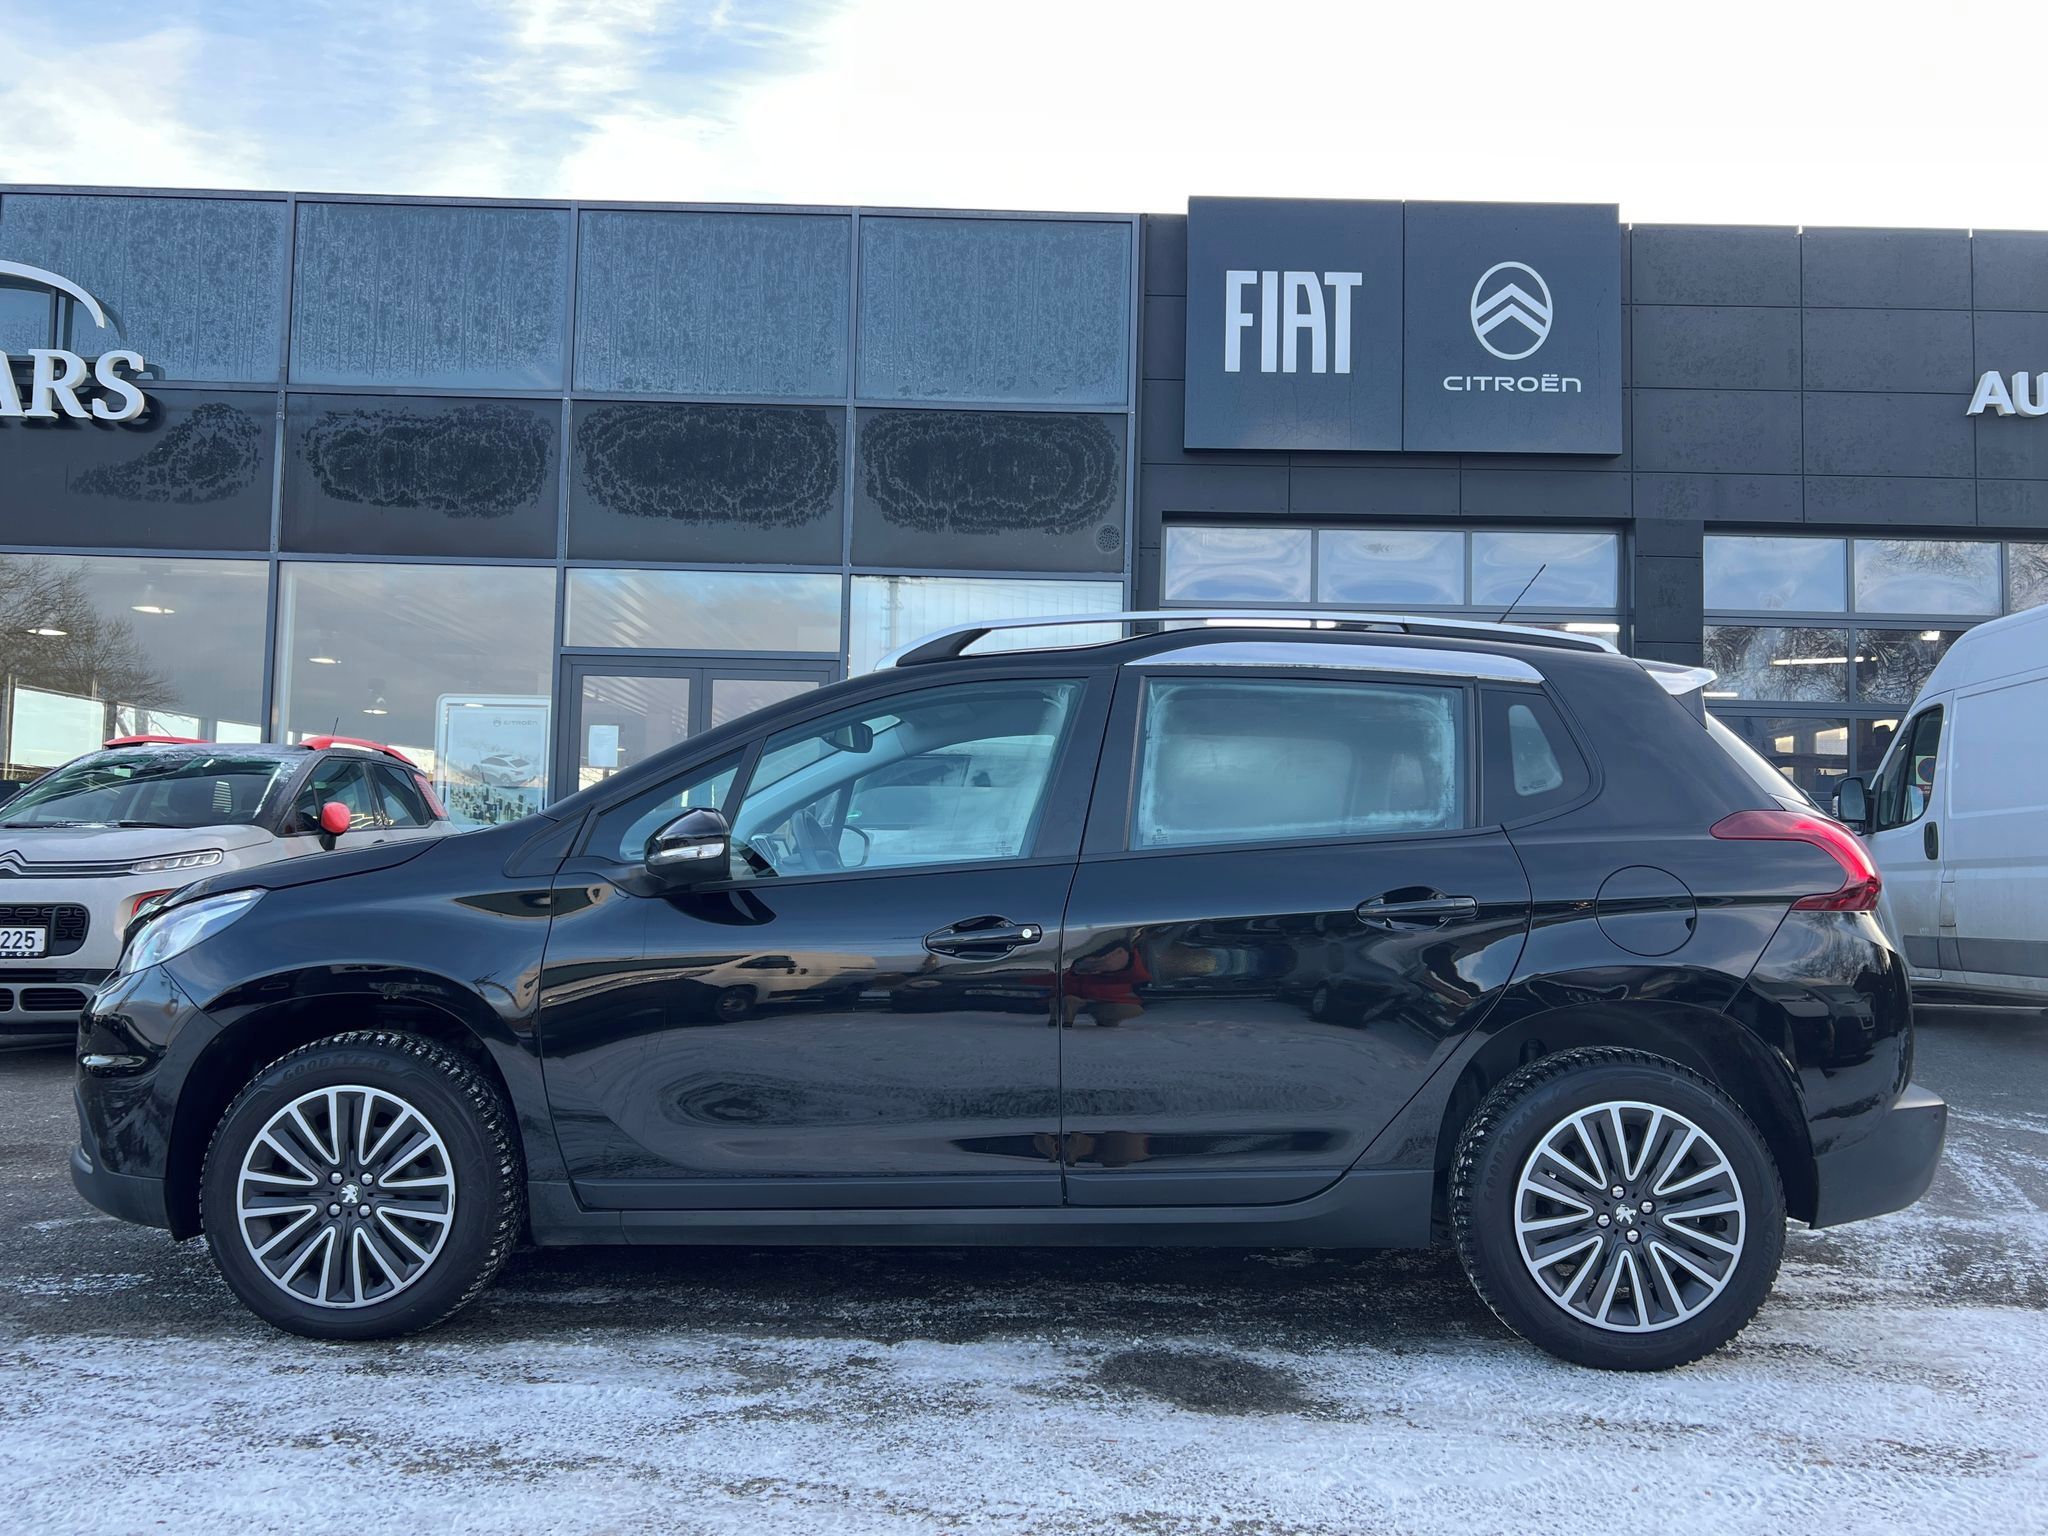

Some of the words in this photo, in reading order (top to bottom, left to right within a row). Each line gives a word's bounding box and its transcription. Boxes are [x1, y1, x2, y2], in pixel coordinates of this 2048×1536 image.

[1225, 270, 1362, 373] FIAT
[1966, 370, 2048, 418] AU
[0, 930, 36, 950] 225
